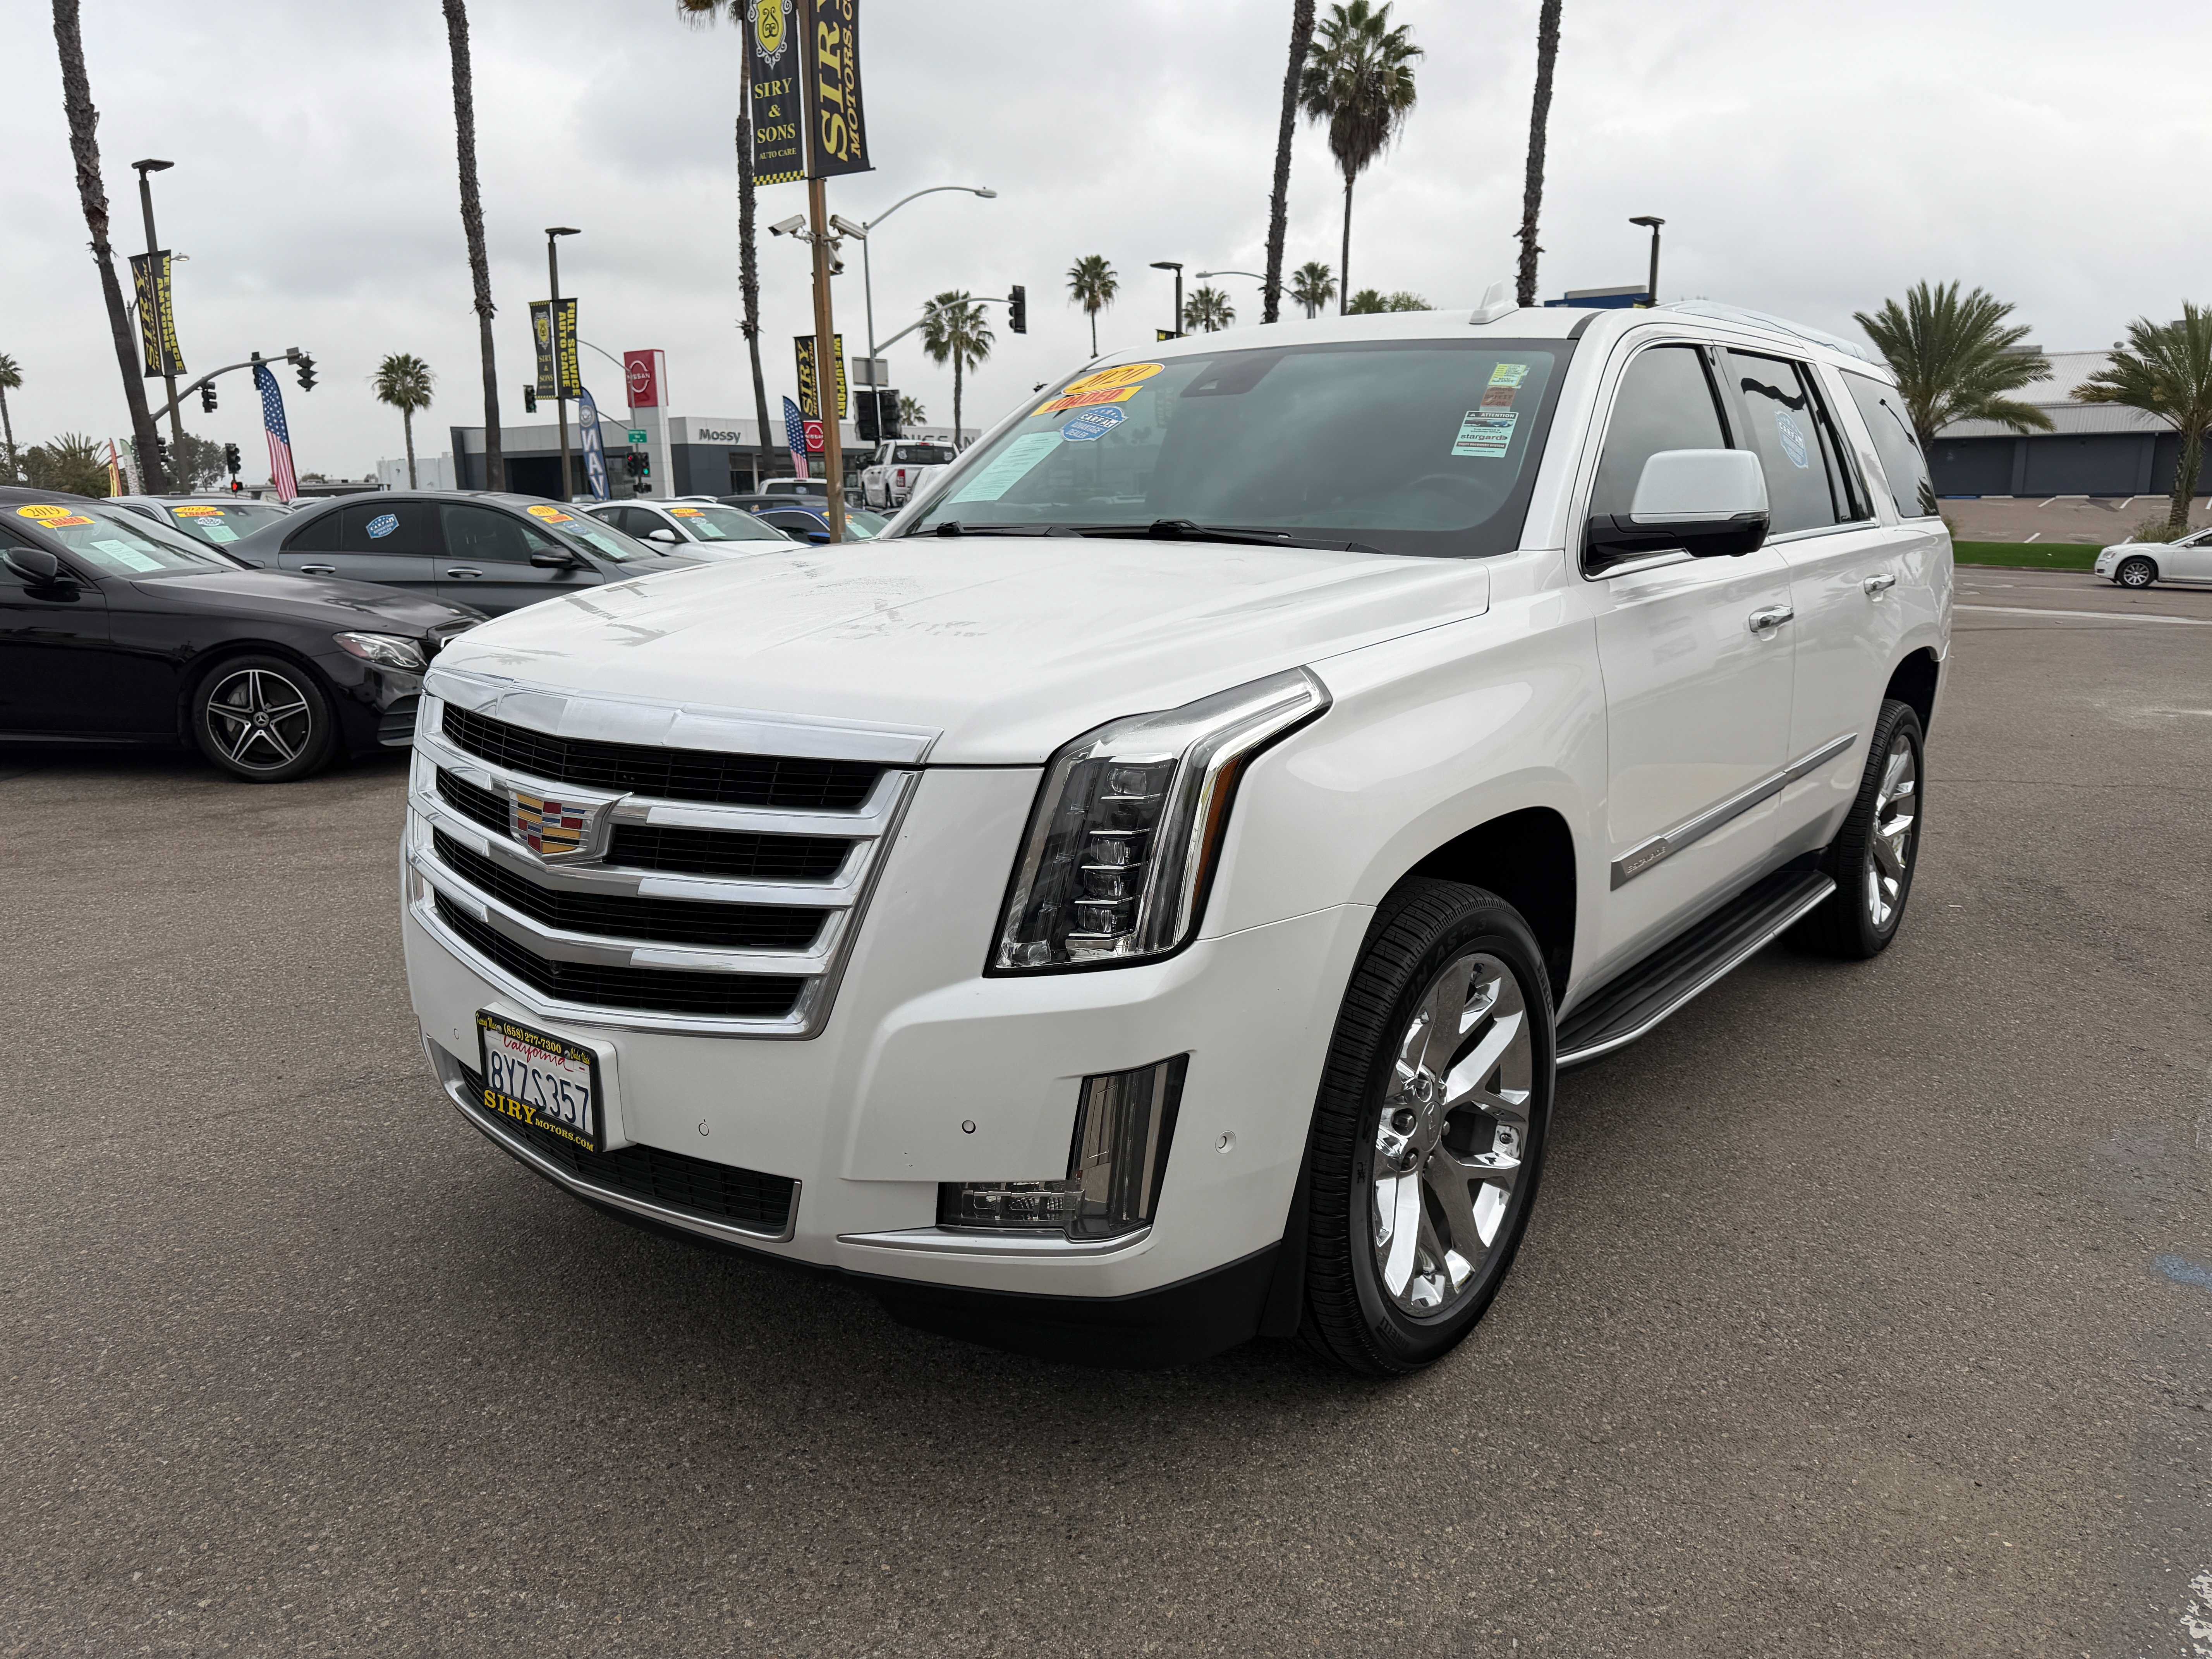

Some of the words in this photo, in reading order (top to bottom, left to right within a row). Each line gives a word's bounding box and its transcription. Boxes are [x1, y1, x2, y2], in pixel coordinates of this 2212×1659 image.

[755, 78, 792, 99] SIRY
[817, 0, 848, 162] SIR
[768, 104, 781, 118] &
[757, 123, 796, 144] SONS
[759, 151, 777, 160] AUTO
[778, 148, 797, 157] CARE
[163, 255, 170, 287] WE
[133, 262, 156, 371] SIRY
[156, 277, 172, 352] ANYONE
[165, 290, 184, 371] FINANCE
[558, 311, 567, 349] AUTO
[567, 302, 575, 332] FULL
[560, 351, 570, 388] CARE
[567, 338, 582, 396] SERVICE
[797, 339, 813, 416] SIRY
[1071, 366, 1152, 391] 2020
[835, 360, 847, 417] SUPPORT
[1043, 388, 1126, 413] LOADED
[699, 429, 741, 444] Mossy
[1080, 413, 1119, 428] CARFAX
[26, 507, 60, 517] 2019
[46, 517, 88, 526] LOADED
[504, 1022, 524, 1041] (858)
[524, 1032, 562, 1054] 277-7300
[504, 1036, 574, 1072] California
[491, 1051, 589, 1130] 8YZS357
[484, 1090, 536, 1125] SIRY
[535, 1118, 595, 1152] MOTORS.COM
